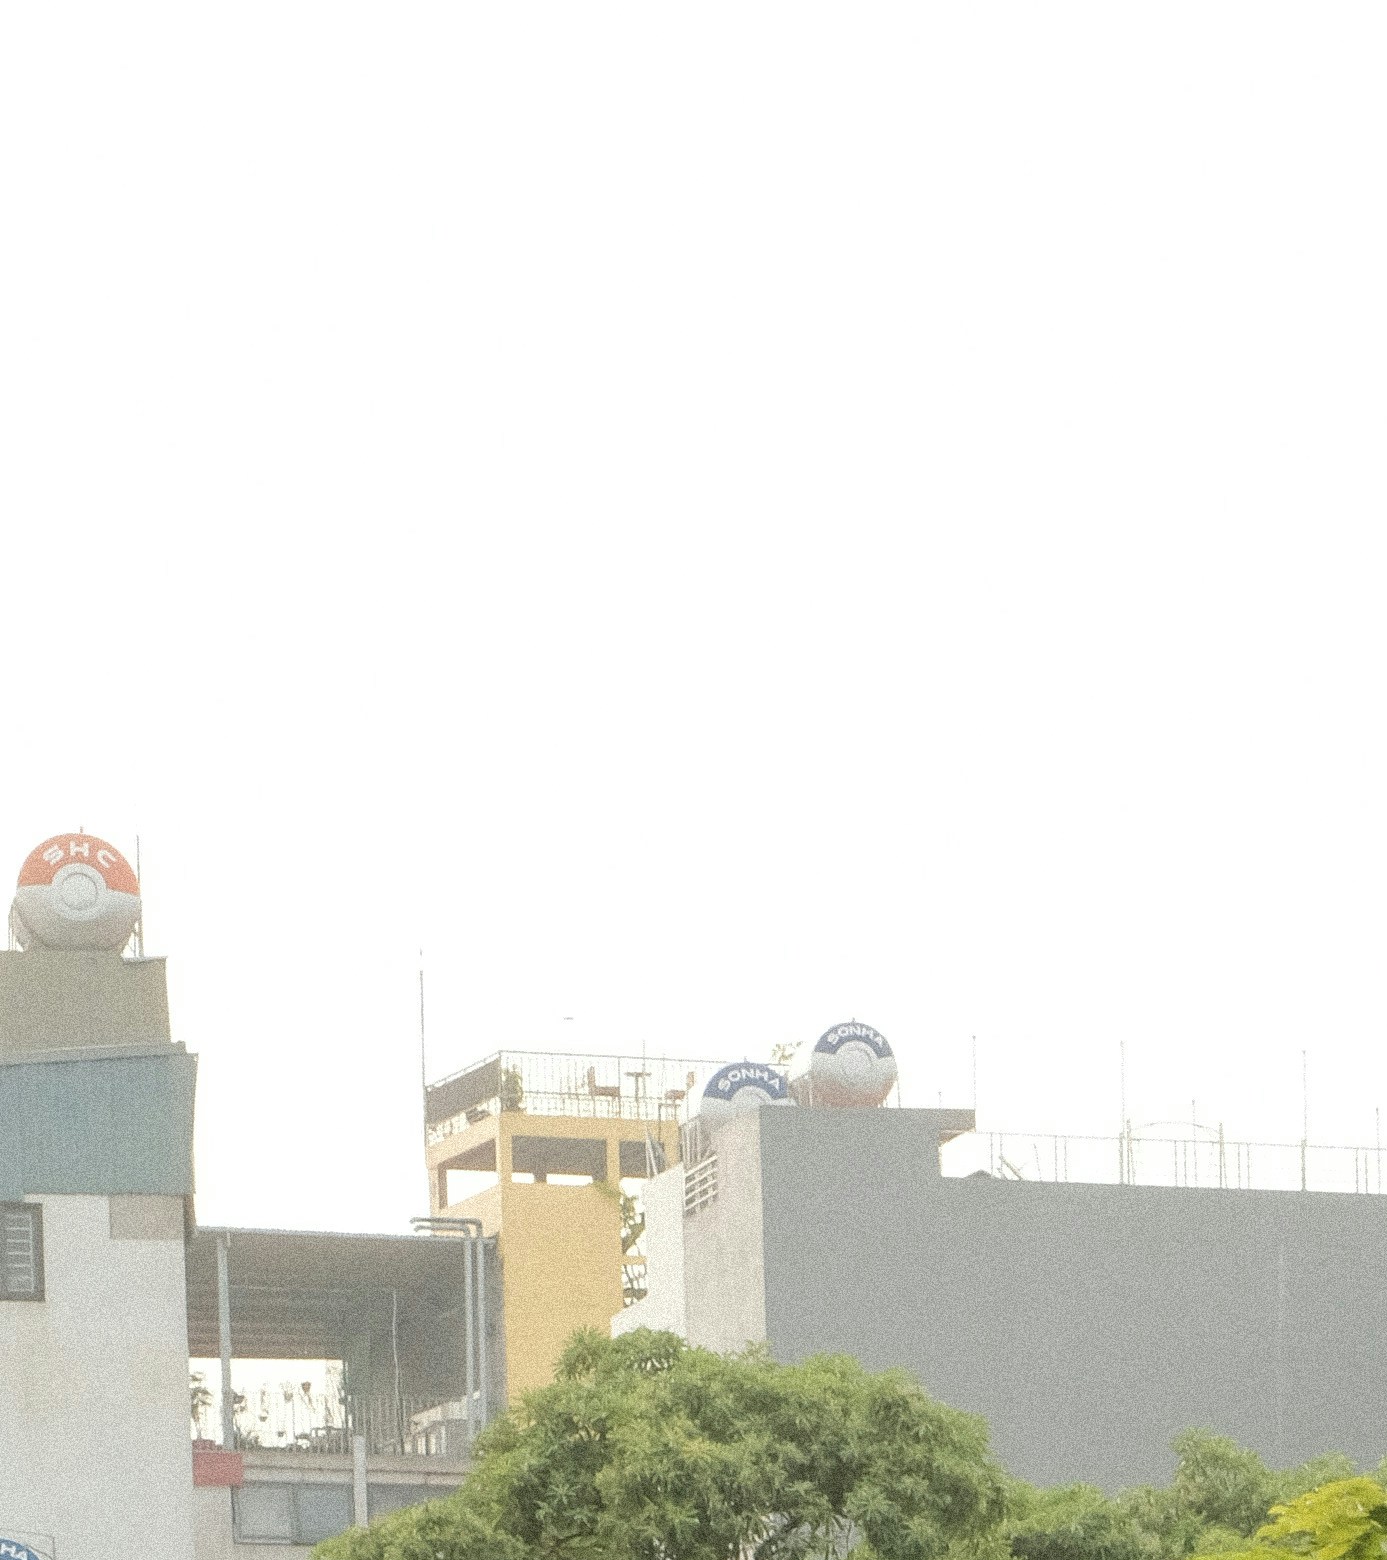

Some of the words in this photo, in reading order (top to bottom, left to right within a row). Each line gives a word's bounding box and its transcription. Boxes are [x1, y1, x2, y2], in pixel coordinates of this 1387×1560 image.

[43, 840, 116, 868] SHC
[827, 1025, 884, 1048] SONHA
[717, 1067, 780, 1091] SONHA
